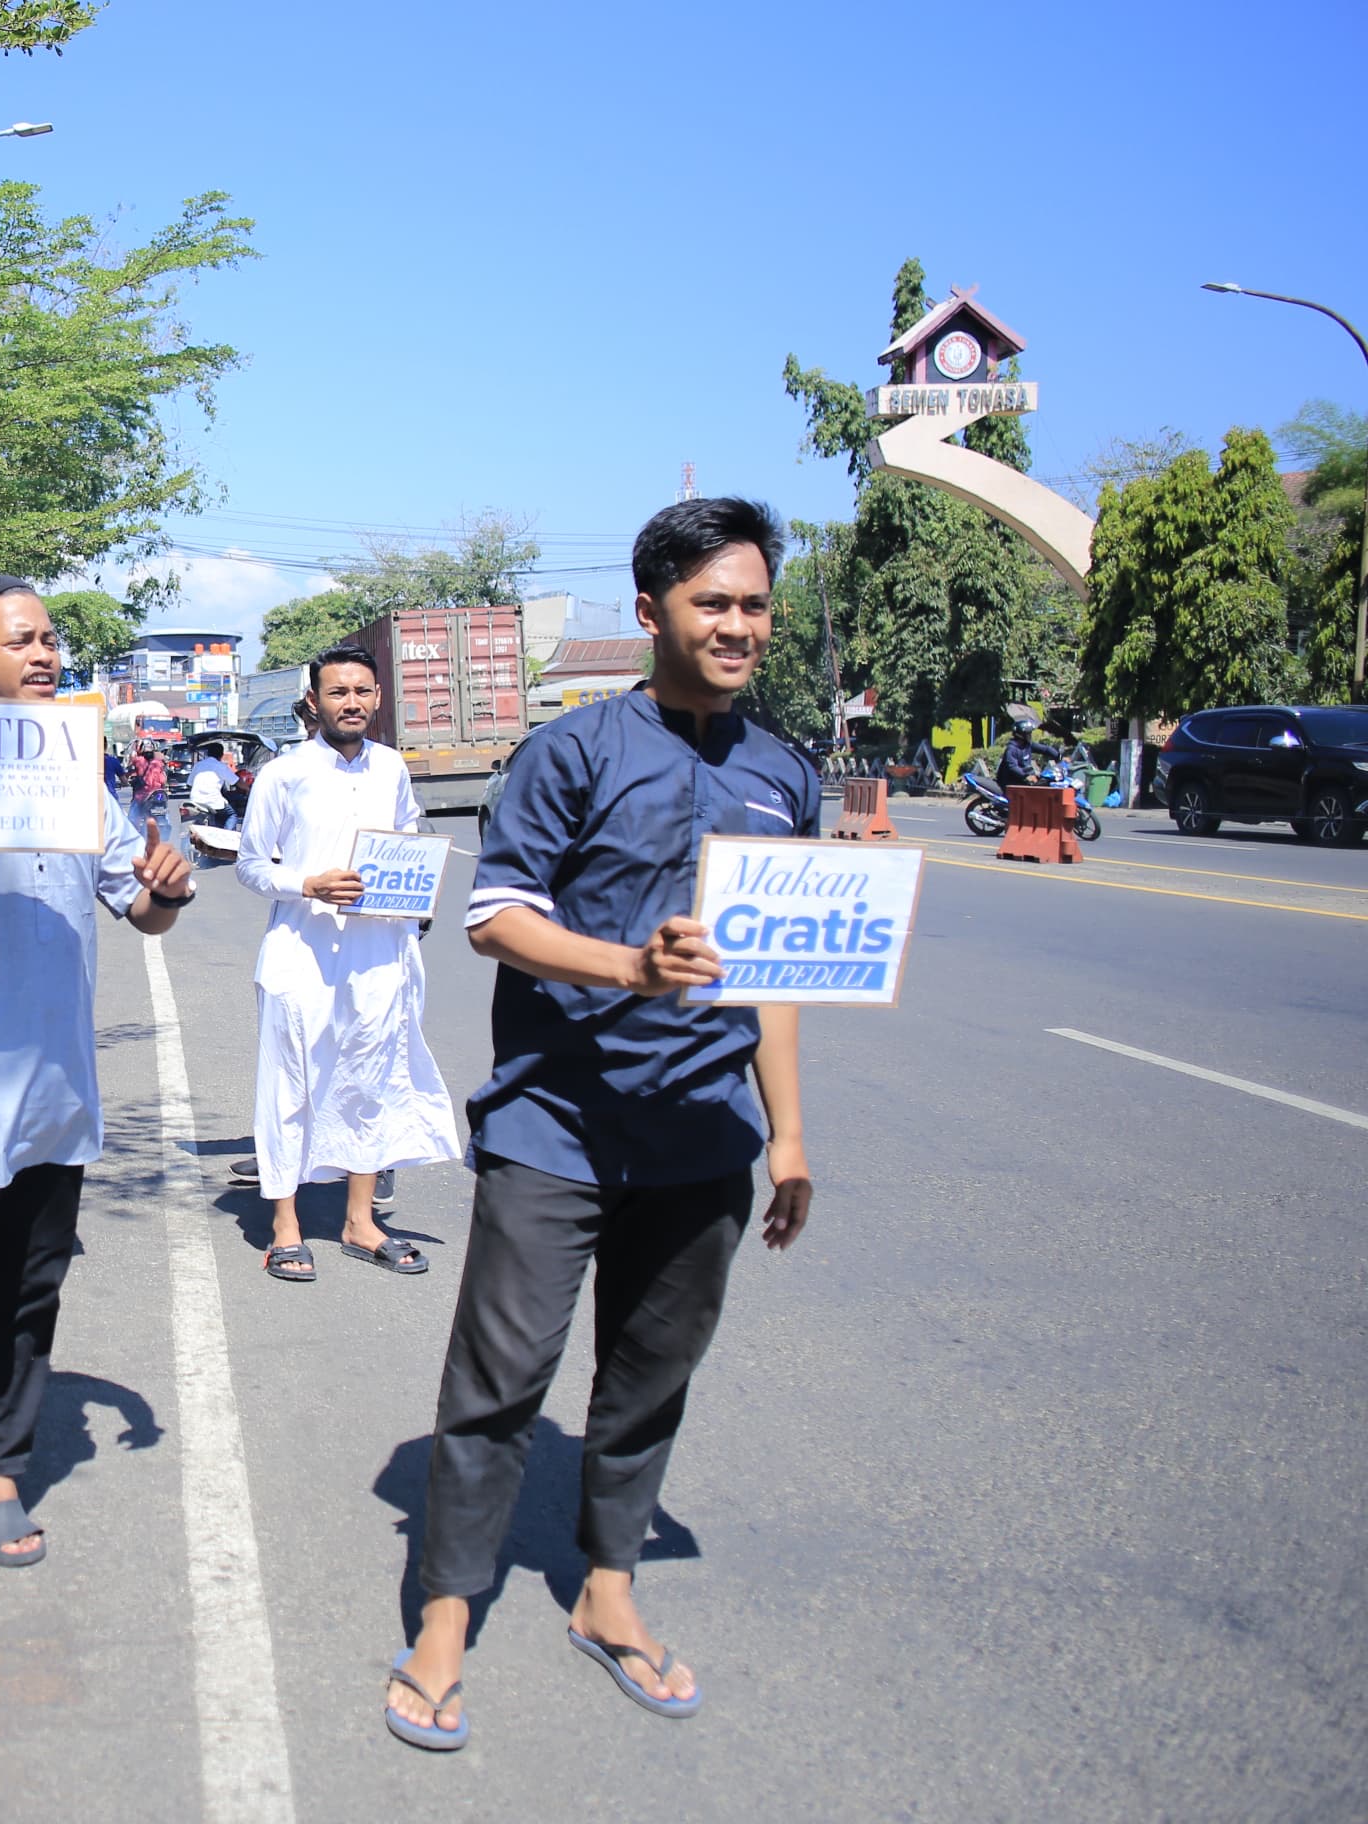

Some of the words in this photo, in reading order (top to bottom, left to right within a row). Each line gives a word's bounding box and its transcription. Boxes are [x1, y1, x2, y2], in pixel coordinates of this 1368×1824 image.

[889, 389, 949, 416] SEMEN
[957, 387, 1028, 413] TONASA
[361, 838, 427, 862] Makan
[358, 863, 436, 892] Gratis
[722, 855, 870, 898] Makan
[714, 902, 895, 954] Gratis
[722, 964, 771, 986] TDA
[774, 965, 876, 988] PEDULI
